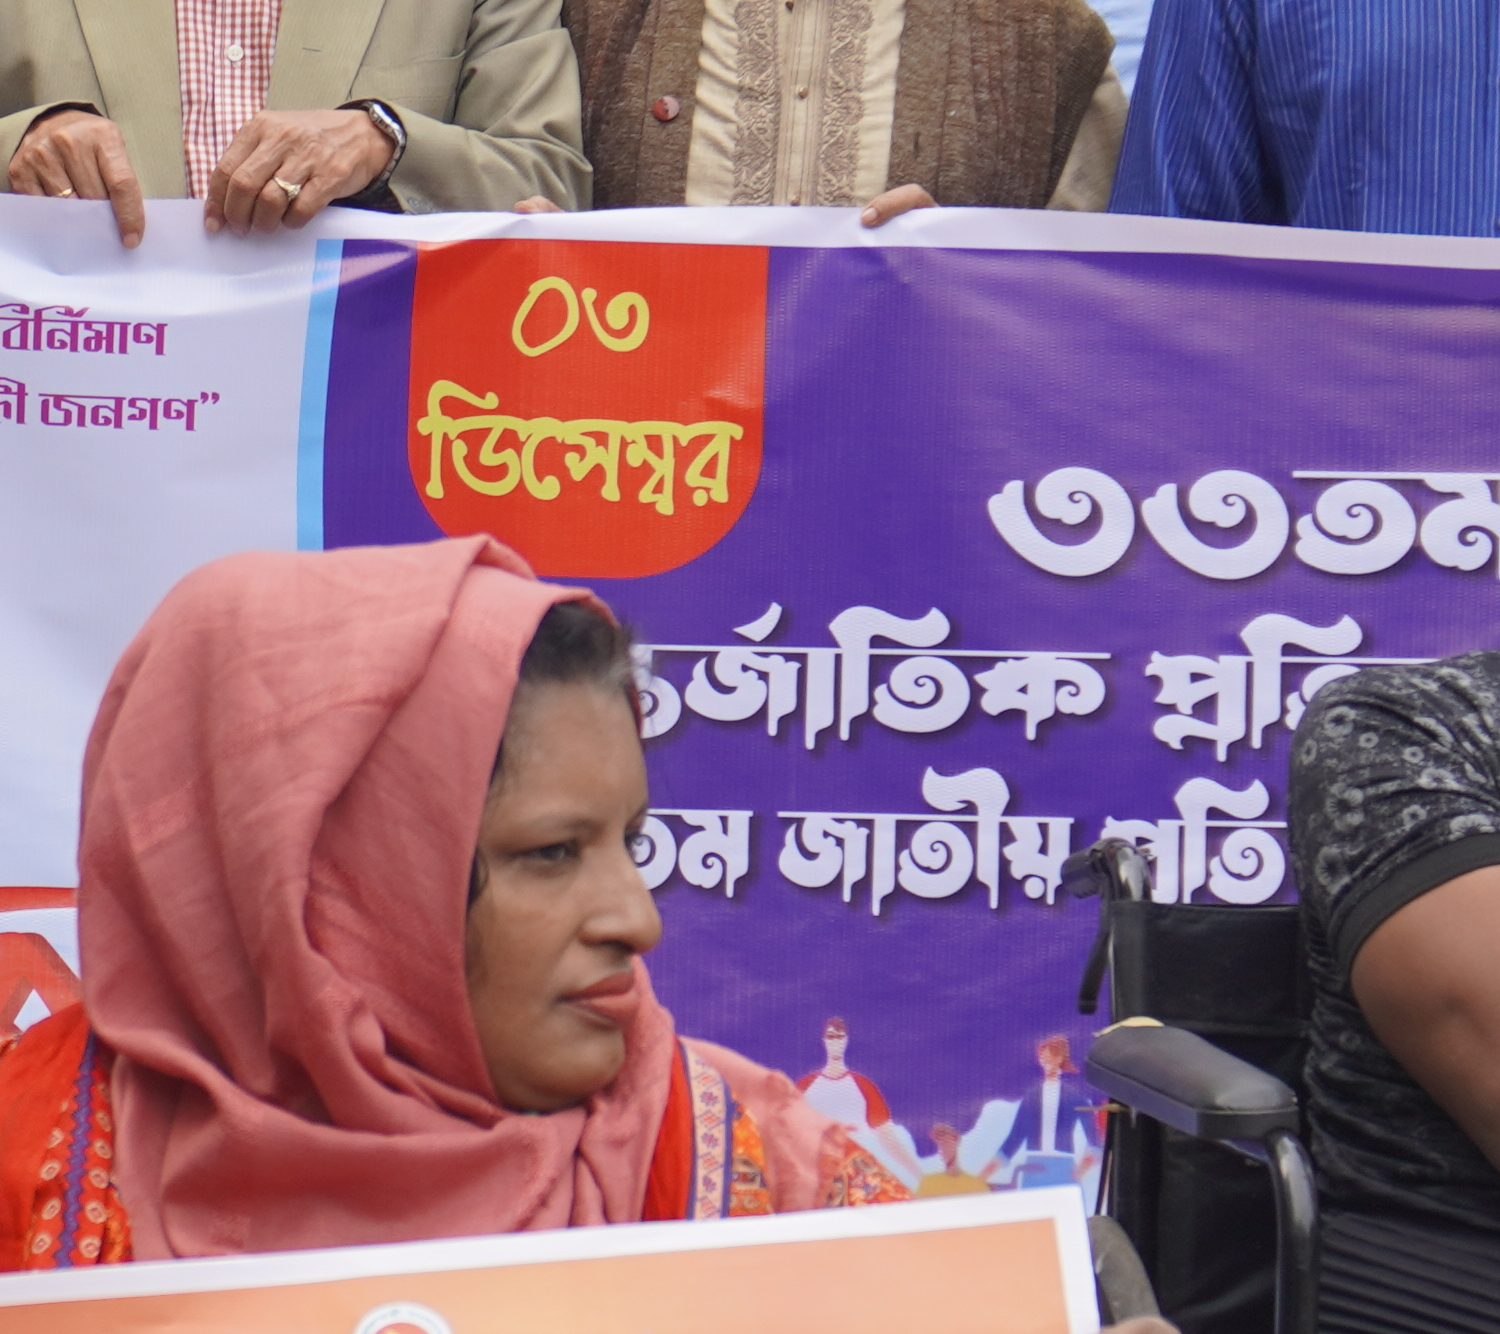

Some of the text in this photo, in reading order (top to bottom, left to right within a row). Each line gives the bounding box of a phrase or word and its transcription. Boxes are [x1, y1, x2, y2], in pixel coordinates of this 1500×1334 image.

[512, 275, 649, 357] ০৩
[417, 379, 744, 515] ডিসেম্বর
[778, 766, 1075, 917] জাতীয়
